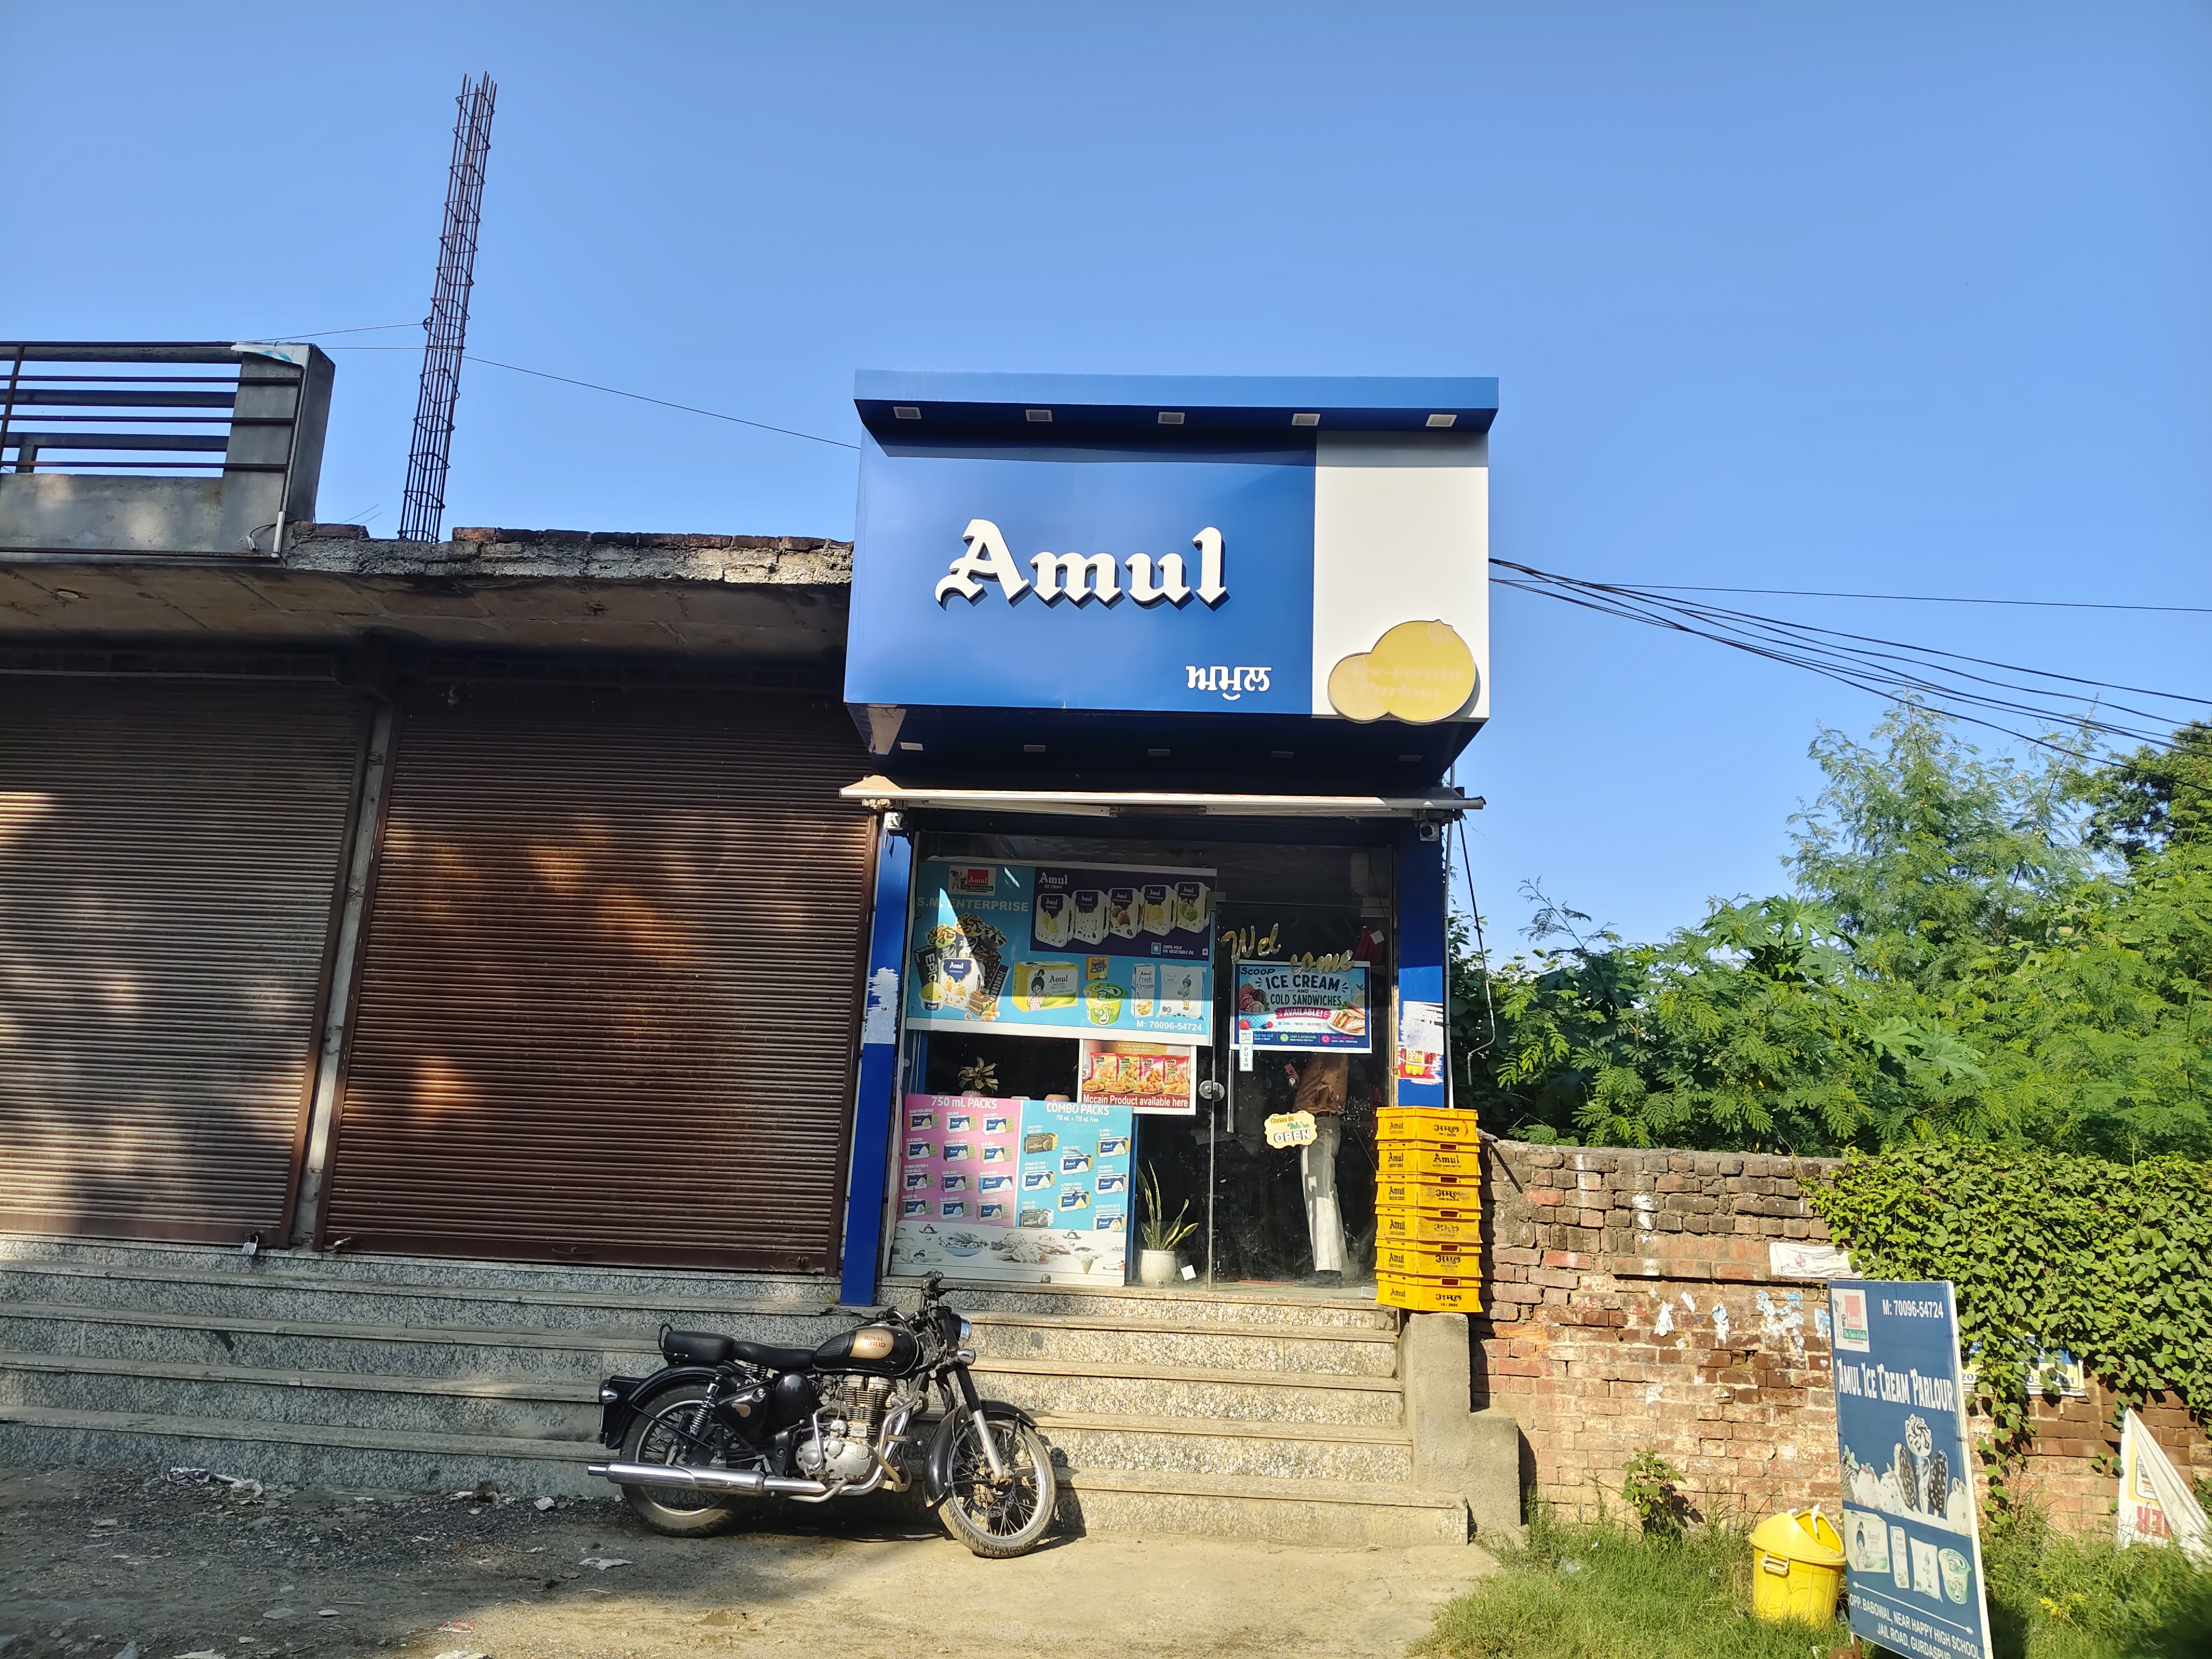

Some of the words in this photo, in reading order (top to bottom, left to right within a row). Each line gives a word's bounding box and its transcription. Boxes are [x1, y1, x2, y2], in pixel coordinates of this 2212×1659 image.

[934, 518, 1228, 610] Amul
[1185, 665, 1272, 701] ਅਮੁਲ
[1039, 872, 1068, 885] Amul
[917, 896, 943, 908] S.M.
[947, 898, 1029, 912] ENTERPRISE
[1265, 975, 1289, 990] ICE
[1293, 974, 1341, 992] CREAM
[1270, 993, 1290, 1005] COLD
[1292, 994, 1342, 1006] SANDWICHES
[1284, 1008, 1323, 1017] AVAILABLE!
[1136, 1020, 1147, 1028] M:
[1149, 1021, 1202, 1031] 70096-54724
[931, 1096, 950, 1107] 750
[952, 1098, 967, 1108] mL
[967, 1098, 997, 1109] PACKS
[1083, 1094, 1108, 1104] Mccain
[1110, 1095, 1137, 1105] Product
[1139, 1096, 1170, 1107] available
[1172, 1096, 1188, 1107] here
[1046, 1103, 1078, 1114] COMBO
[1081, 1105, 1110, 1116] PACKS
[1273, 1129, 1311, 1143] OPEN
[1388, 1152, 1404, 1162] Amul
[1433, 1153, 1460, 1164] Amul
[1389, 1186, 1404, 1195] Amul
[1390, 1219, 1405, 1230] Amul
[1389, 1253, 1404, 1264] Amul
[1390, 1289, 1405, 1298] Amul
[1882, 1299, 1892, 1316] M:
[1893, 1300, 1944, 1318] 70096-54724
[1837, 1357, 1862, 1396] AMUL
[1861, 1362, 1878, 1399] ICE
[1877, 1363, 1911, 1405] CREAM
[1910, 1368, 1956, 1412] PARLOUR
[1849, 1593, 1863, 1610] OPP.
[1863, 1599, 1893, 1624] BABOWAL,
[1893, 1610, 1911, 1630] NEAR
[1911, 1618, 1933, 1639] HAPPY
[1933, 1629, 1951, 1647] HIGH
[1877, 1622, 1891, 1640] JAIL
[1890, 1628, 1911, 1650] ROAD,
[1910, 1636, 1952, 1659] GURDASPUR
